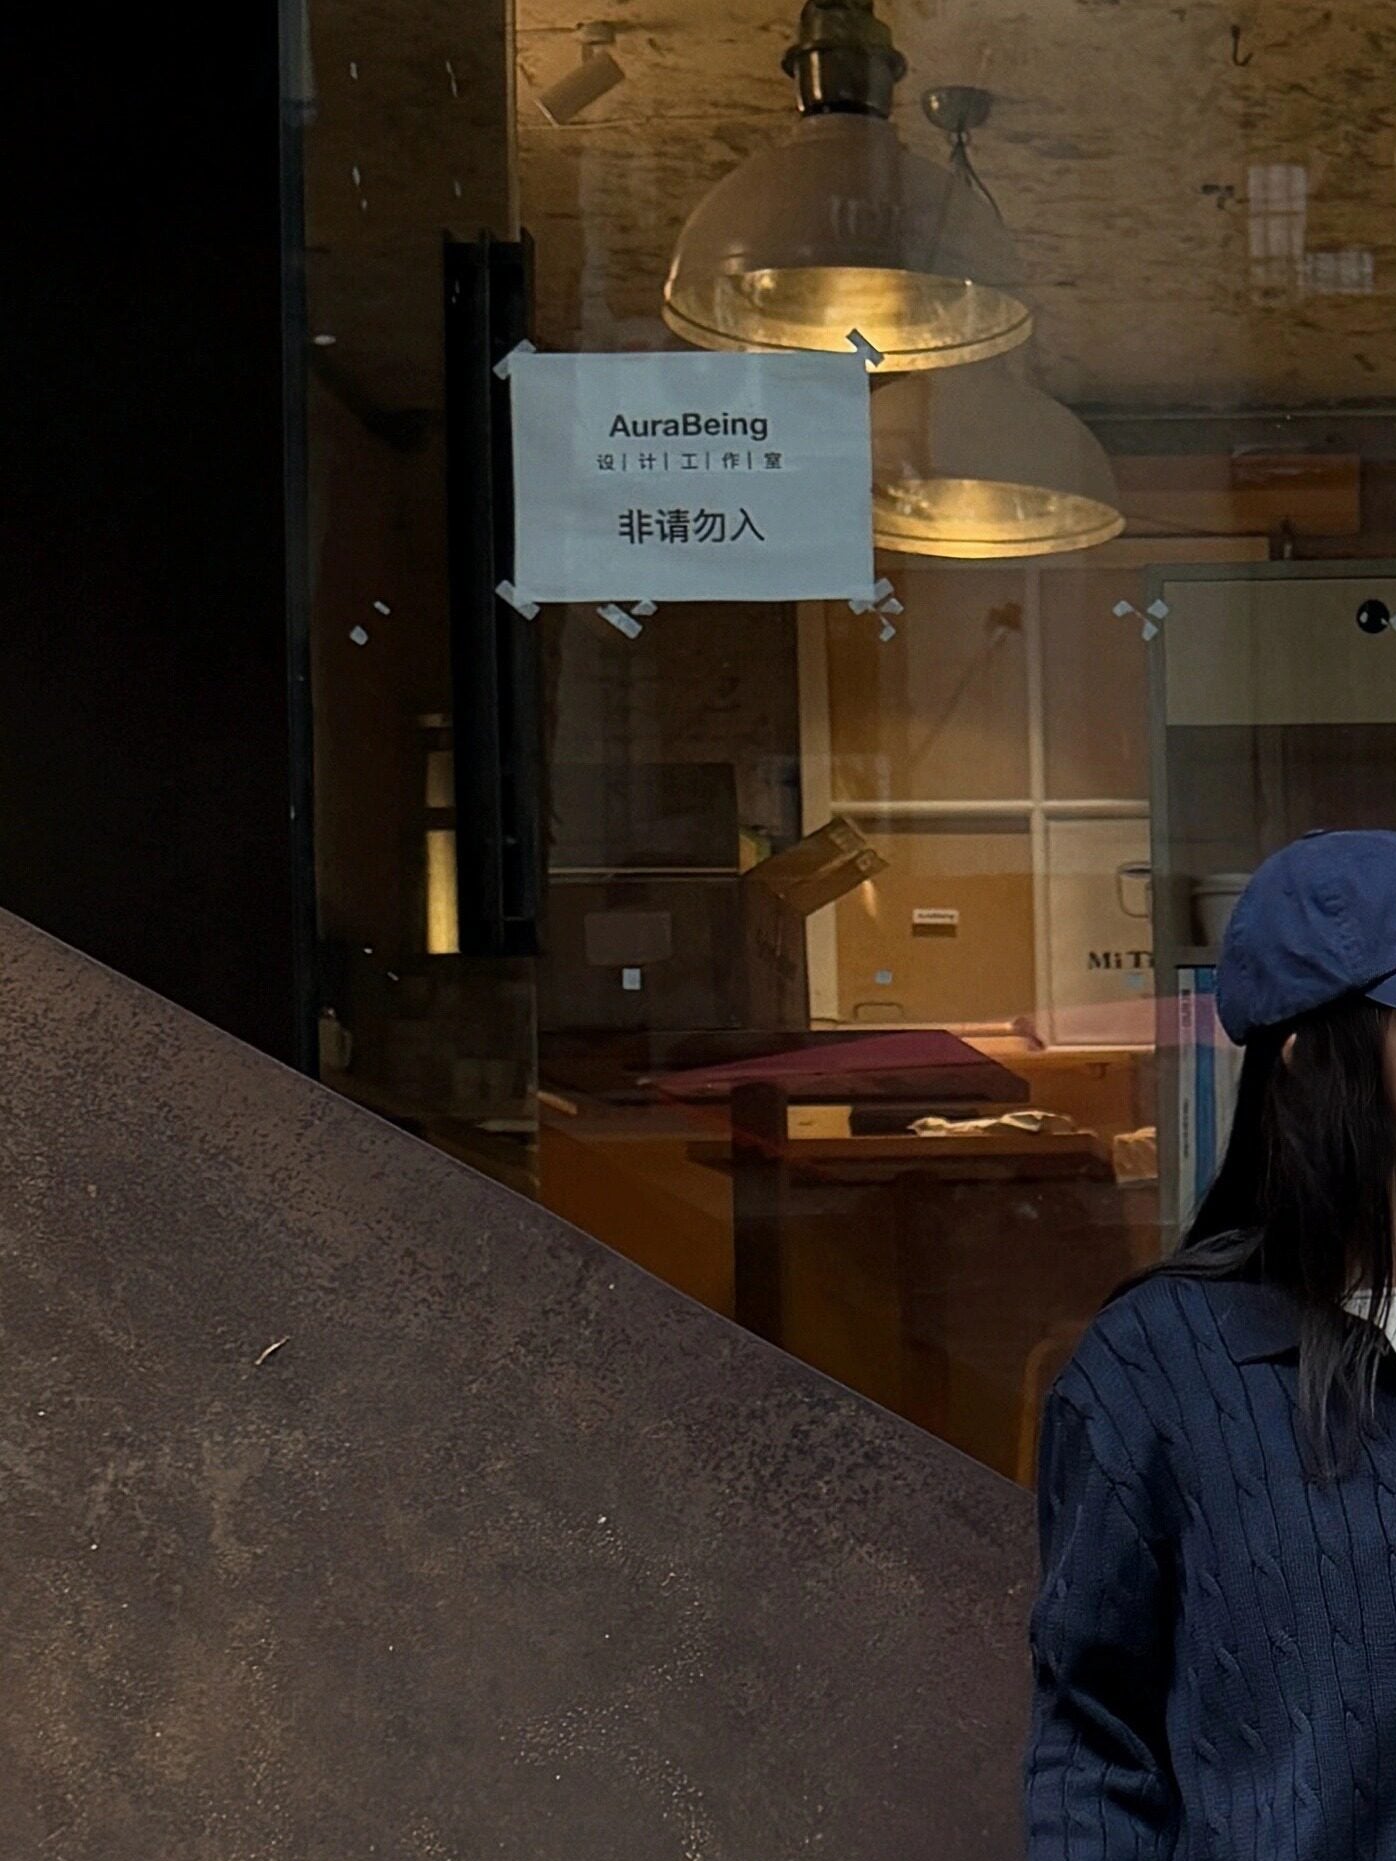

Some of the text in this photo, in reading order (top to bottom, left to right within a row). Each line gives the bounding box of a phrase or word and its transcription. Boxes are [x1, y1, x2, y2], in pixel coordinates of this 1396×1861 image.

[609, 412, 769, 441] AuraBeing
[617, 507, 765, 545] 非请勿入
[1088, 951, 1122, 970] Mi
